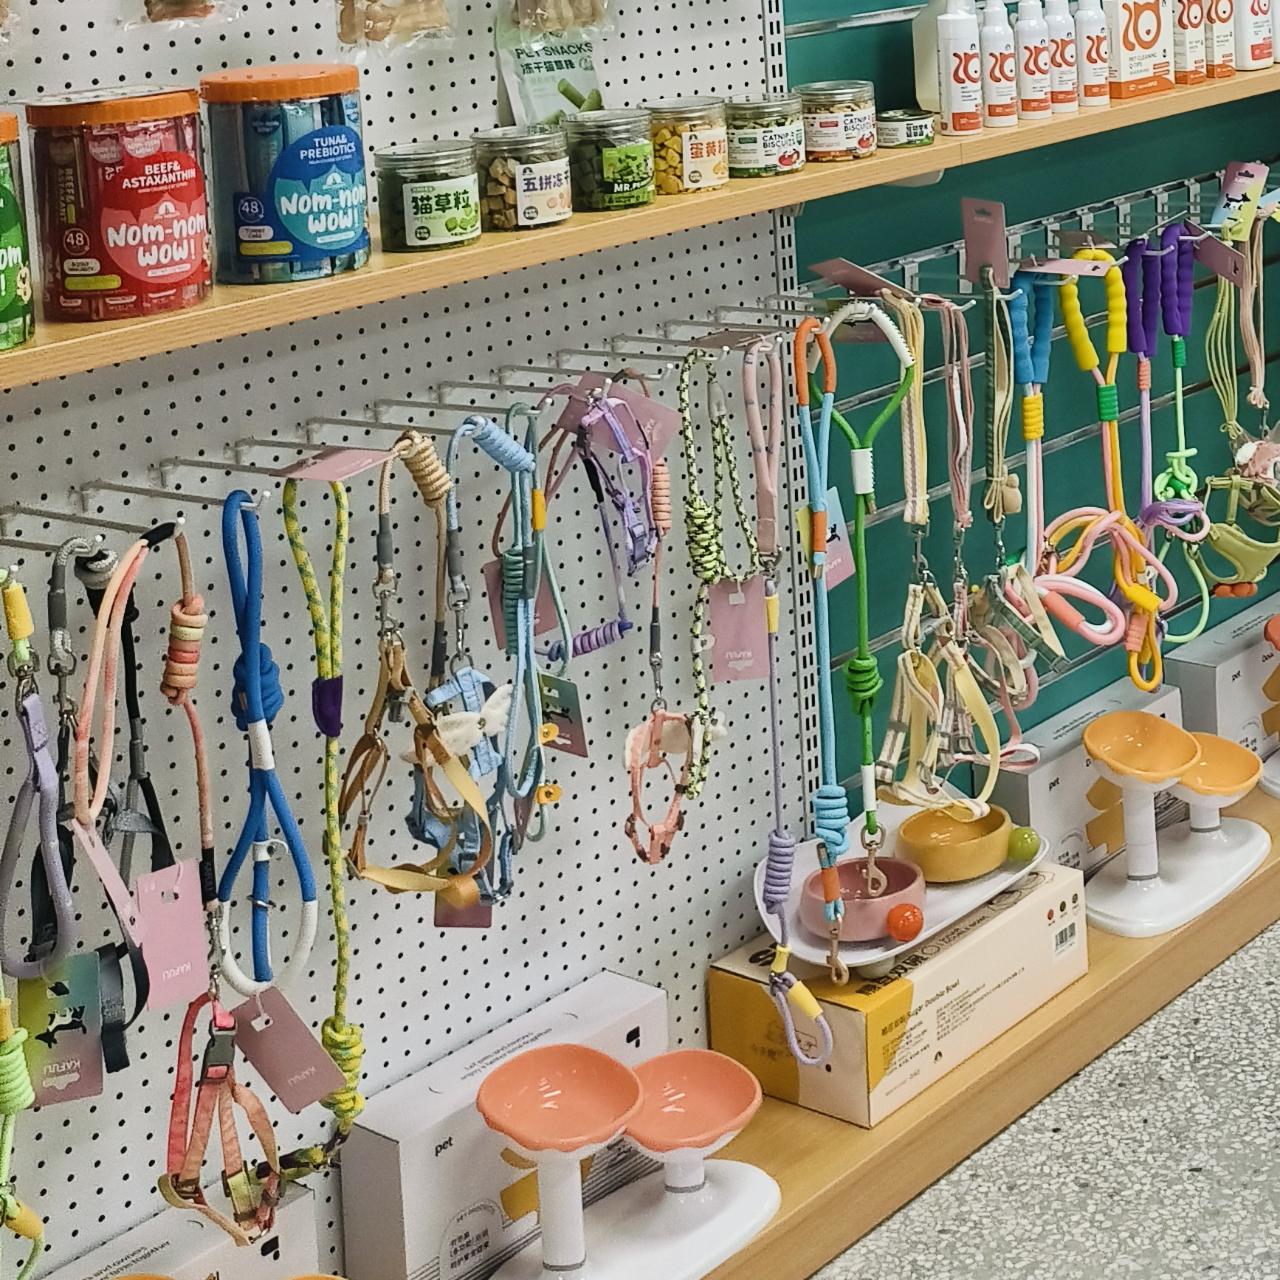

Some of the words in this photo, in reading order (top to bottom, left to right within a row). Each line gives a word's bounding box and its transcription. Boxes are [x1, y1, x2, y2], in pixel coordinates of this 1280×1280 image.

[542, 42, 593, 57] SNACKS
[313, 134, 348, 147] TUNA&
[300, 142, 357, 160] PREBIOTICS
[144, 160, 181, 176] BEEF&
[122, 167, 197, 189] ASTAXANTHIN
[410, 189, 471, 216] 猫草粒
[434, 1136, 455, 1157] pet
